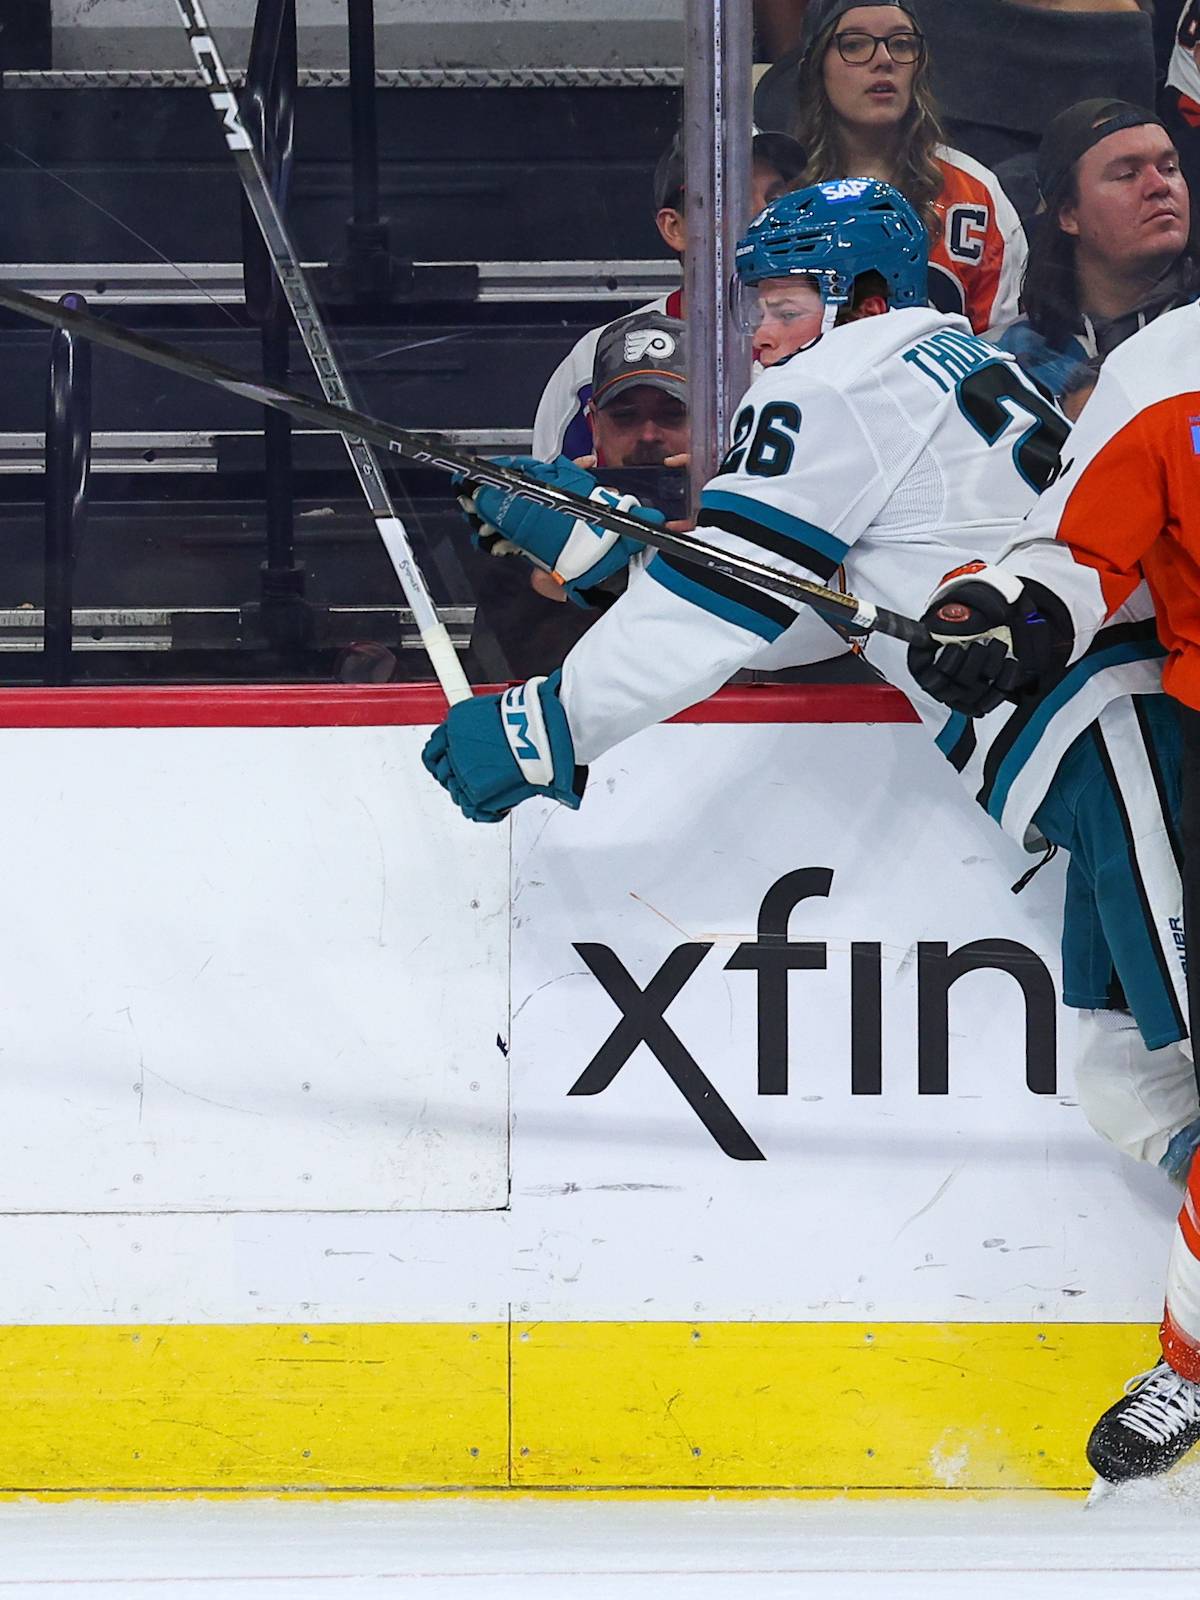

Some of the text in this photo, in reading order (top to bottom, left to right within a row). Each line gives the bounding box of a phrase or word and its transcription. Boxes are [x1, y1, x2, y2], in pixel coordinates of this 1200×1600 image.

[820, 181, 868, 201] SAP
[945, 203, 989, 267] C
[717, 400, 802, 477] 26
